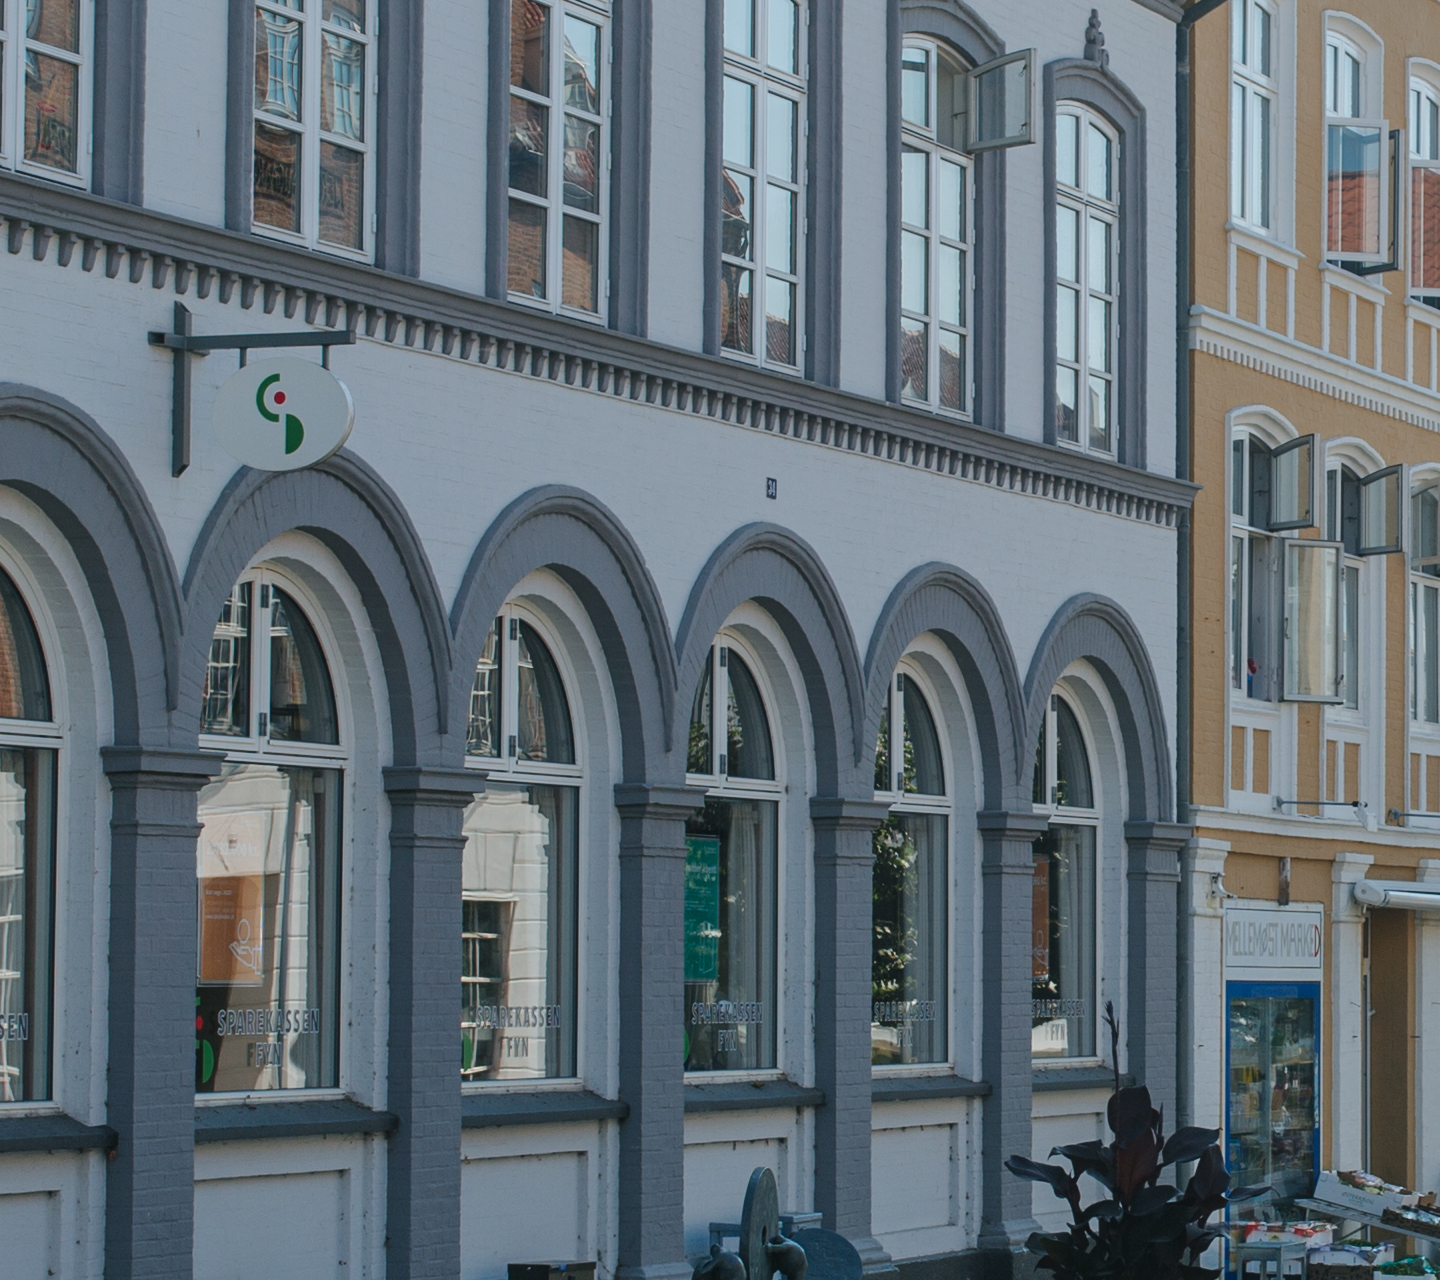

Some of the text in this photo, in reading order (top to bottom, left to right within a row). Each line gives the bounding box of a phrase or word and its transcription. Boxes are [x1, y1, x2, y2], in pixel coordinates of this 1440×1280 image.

[768, 479, 776, 497] 34
[1226, 920, 1322, 958] MELLEMØST MARKED
[217, 1008, 319, 1036] SPAREKASSEN
[476, 1005, 561, 1029] SPAREKASSEN
[691, 1002, 763, 1024] SPAREKASSEN
[507, 1037, 529, 1057] FYN
[718, 1029, 737, 1052] FYN
[255, 1042, 282, 1068] FYN
